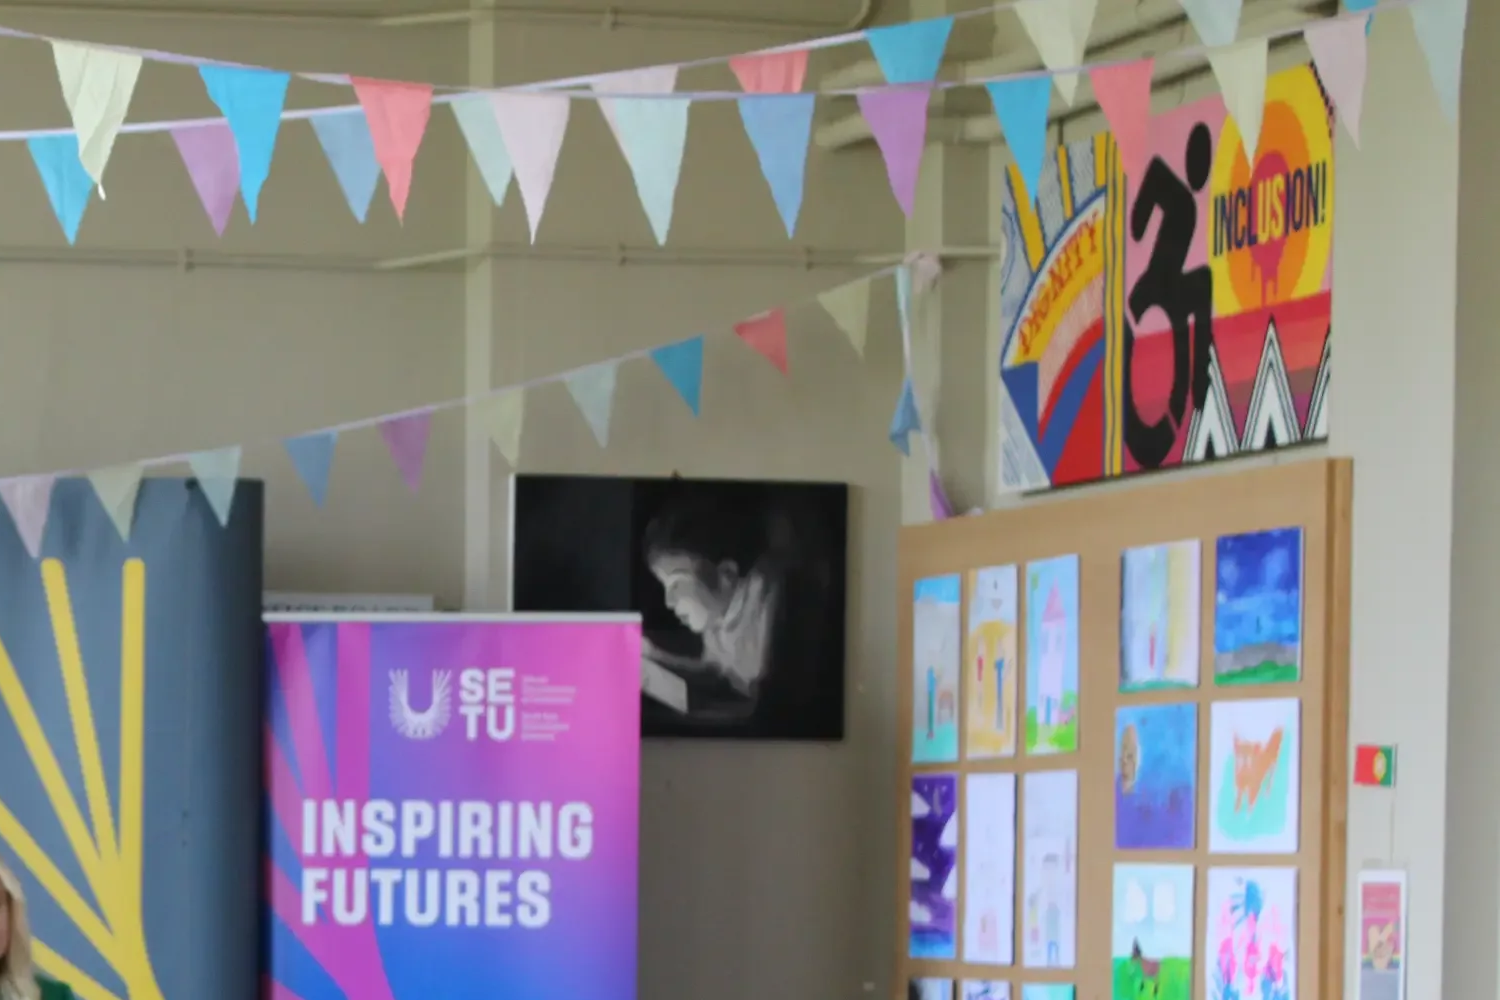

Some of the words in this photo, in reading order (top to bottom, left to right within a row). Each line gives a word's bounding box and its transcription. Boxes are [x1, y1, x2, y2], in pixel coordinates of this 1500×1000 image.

[1213, 160, 1327, 257] INCLUSION!
[459, 667, 515, 704] SE
[459, 705, 515, 741] TU
[301, 798, 593, 859] INSPIRING
[300, 866, 551, 929] FUTURES
